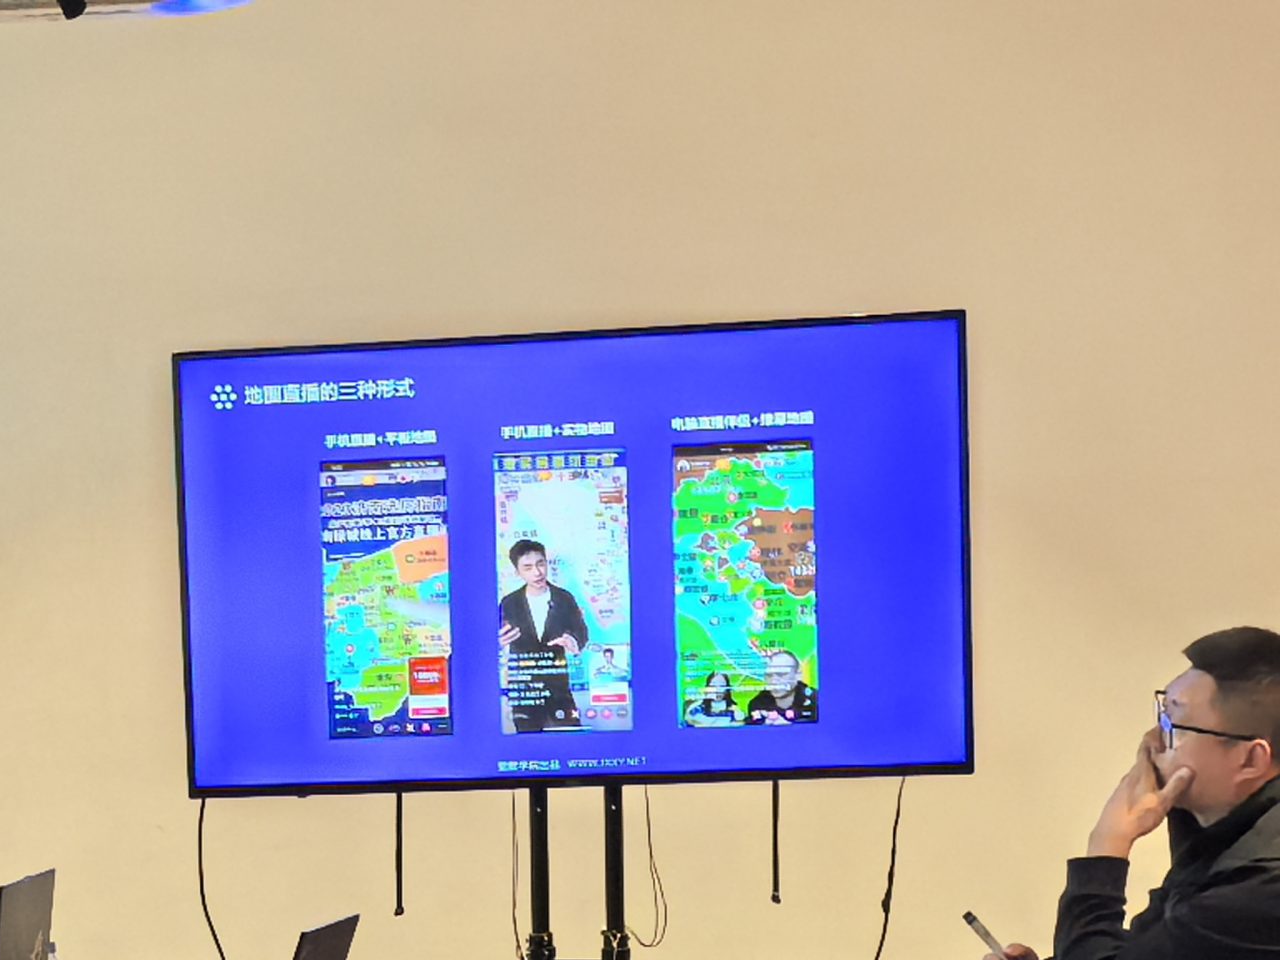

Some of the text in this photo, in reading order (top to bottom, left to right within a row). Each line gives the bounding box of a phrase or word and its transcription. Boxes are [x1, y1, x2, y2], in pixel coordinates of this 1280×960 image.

[243, 376, 416, 405] 地图直播的三种形式
